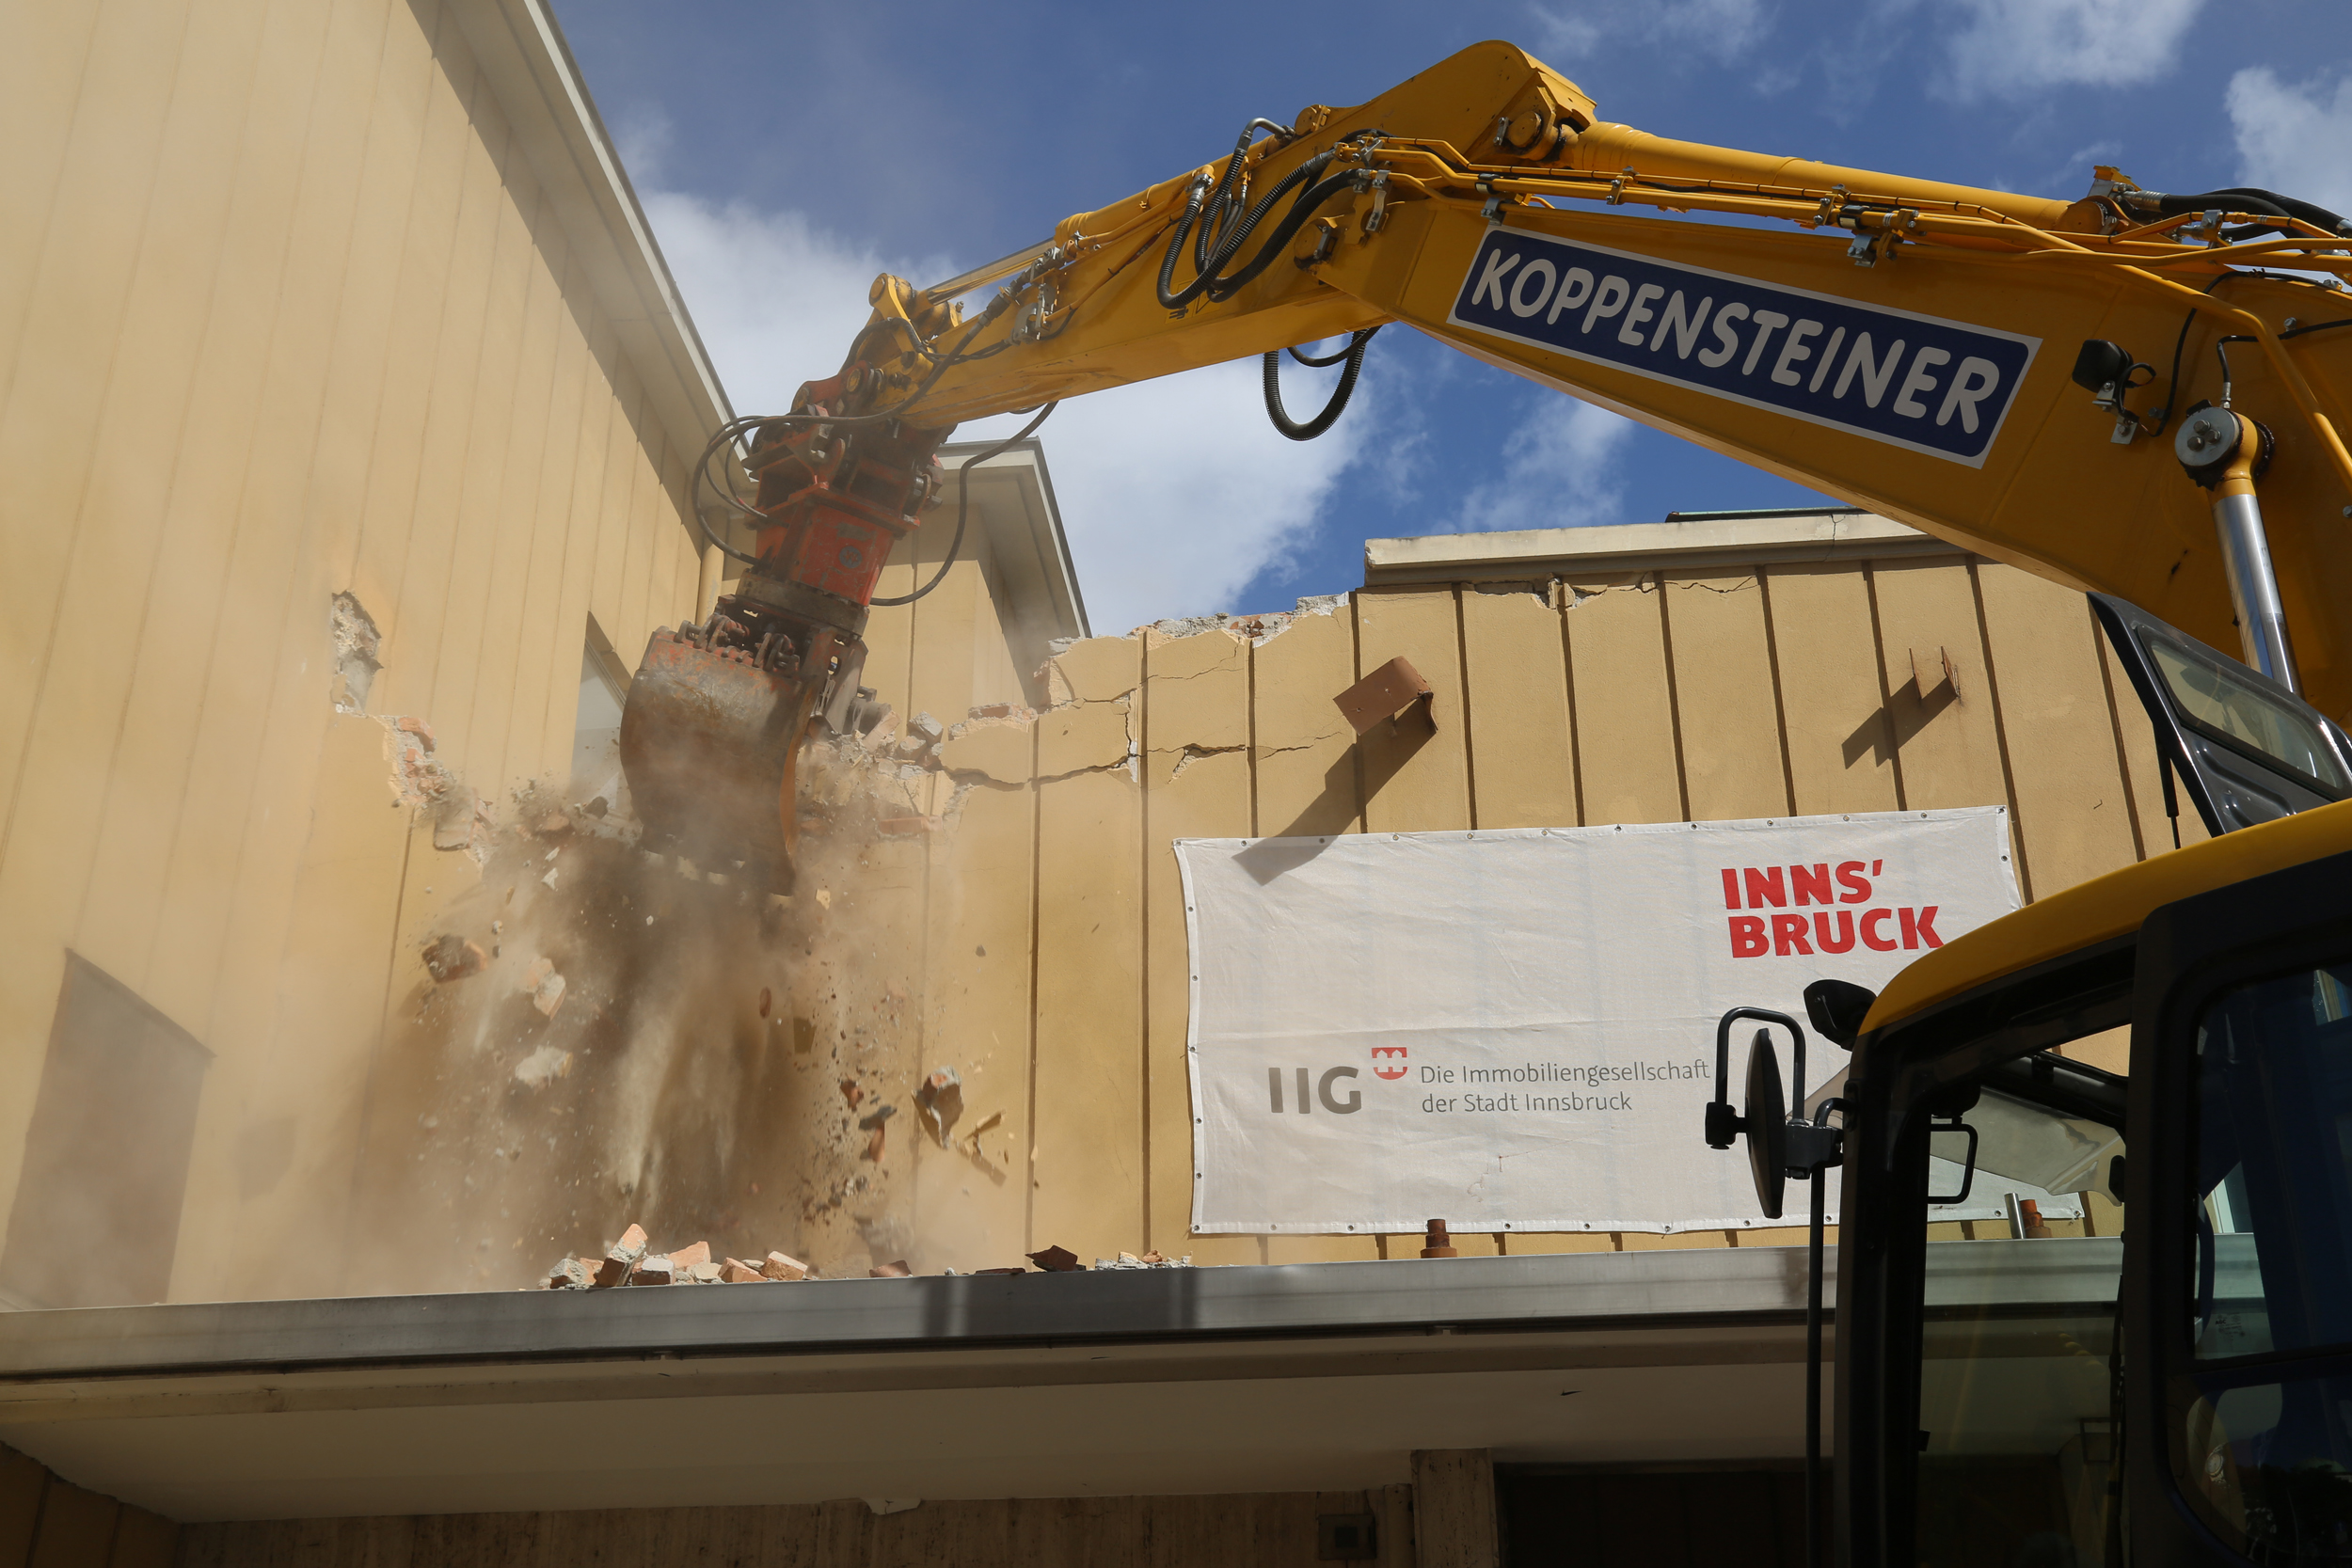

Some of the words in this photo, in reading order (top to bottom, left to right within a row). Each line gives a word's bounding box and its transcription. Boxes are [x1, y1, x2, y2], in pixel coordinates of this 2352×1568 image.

[1471, 247, 2000, 435] KOPPENSTEINER
[1727, 905, 1945, 958] BRUCK
[1268, 1066, 1362, 1115] IIG
[1421, 1065, 1454, 1084] Die
[1463, 1059, 1710, 1087] Immobiliengesellschaft
[1422, 1093, 1457, 1113] der
[1464, 1092, 1519, 1112] Stadt
[1525, 1091, 1633, 1112] Innsbruck
